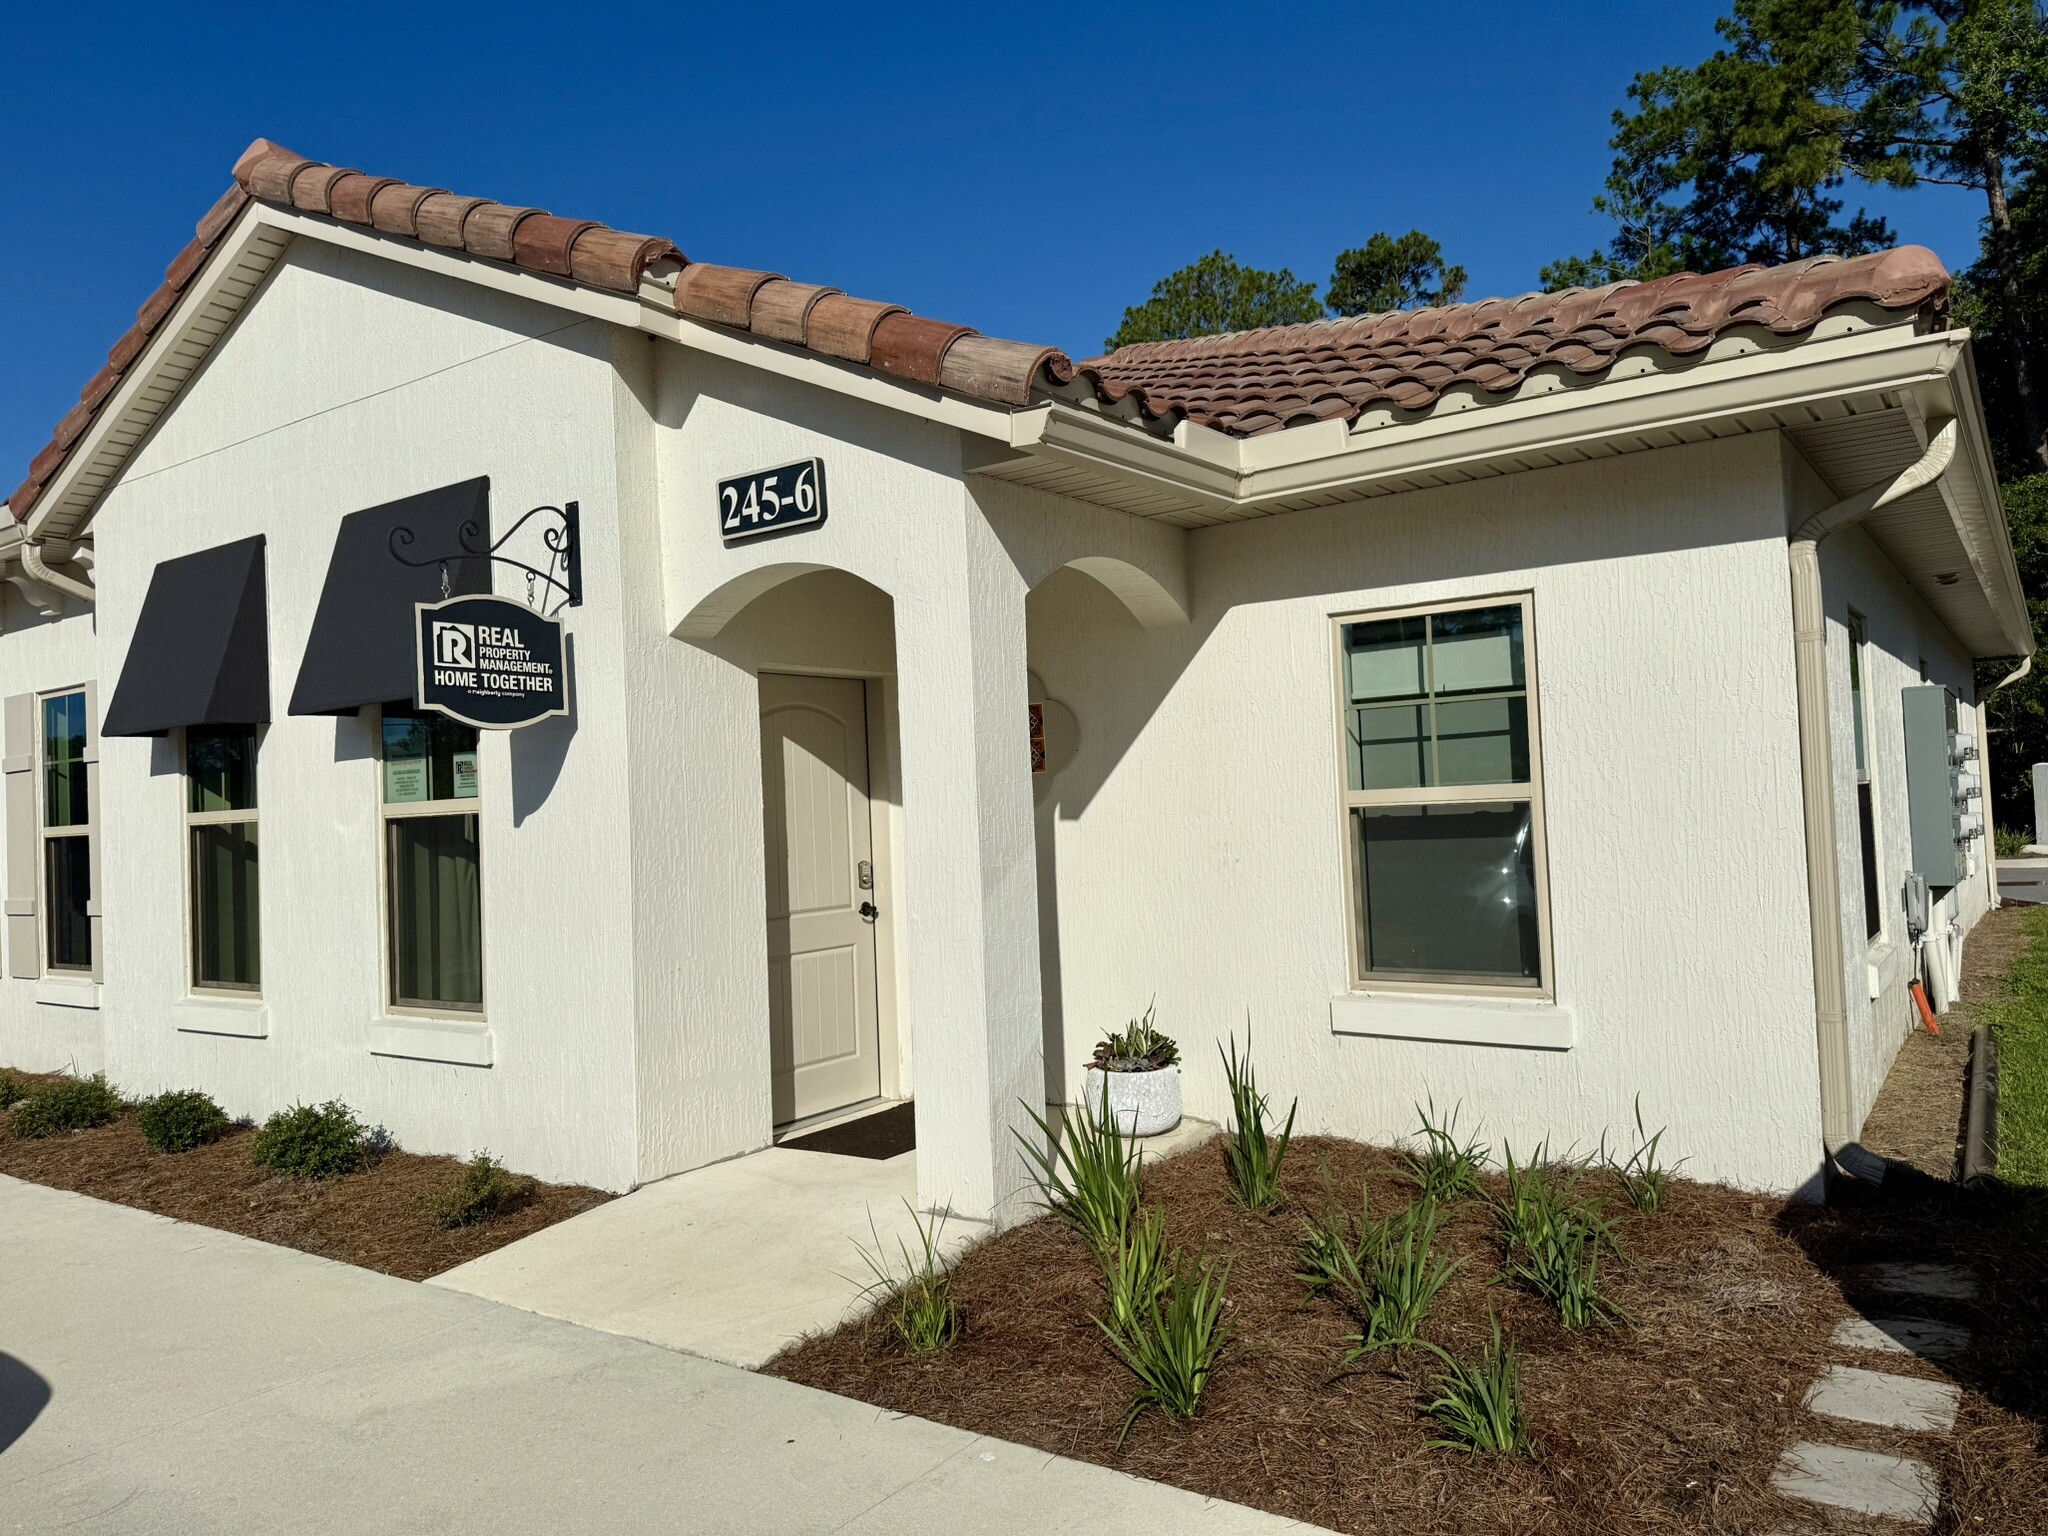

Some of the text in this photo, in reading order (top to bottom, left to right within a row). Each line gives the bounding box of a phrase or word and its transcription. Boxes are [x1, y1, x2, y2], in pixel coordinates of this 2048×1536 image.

[722, 466, 814, 529] 245-6
[478, 625, 525, 648] REAL
[479, 646, 531, 661] PROPERTY
[434, 670, 553, 692] HOME TOGETHER
[472, 689, 501, 697] neighborly
